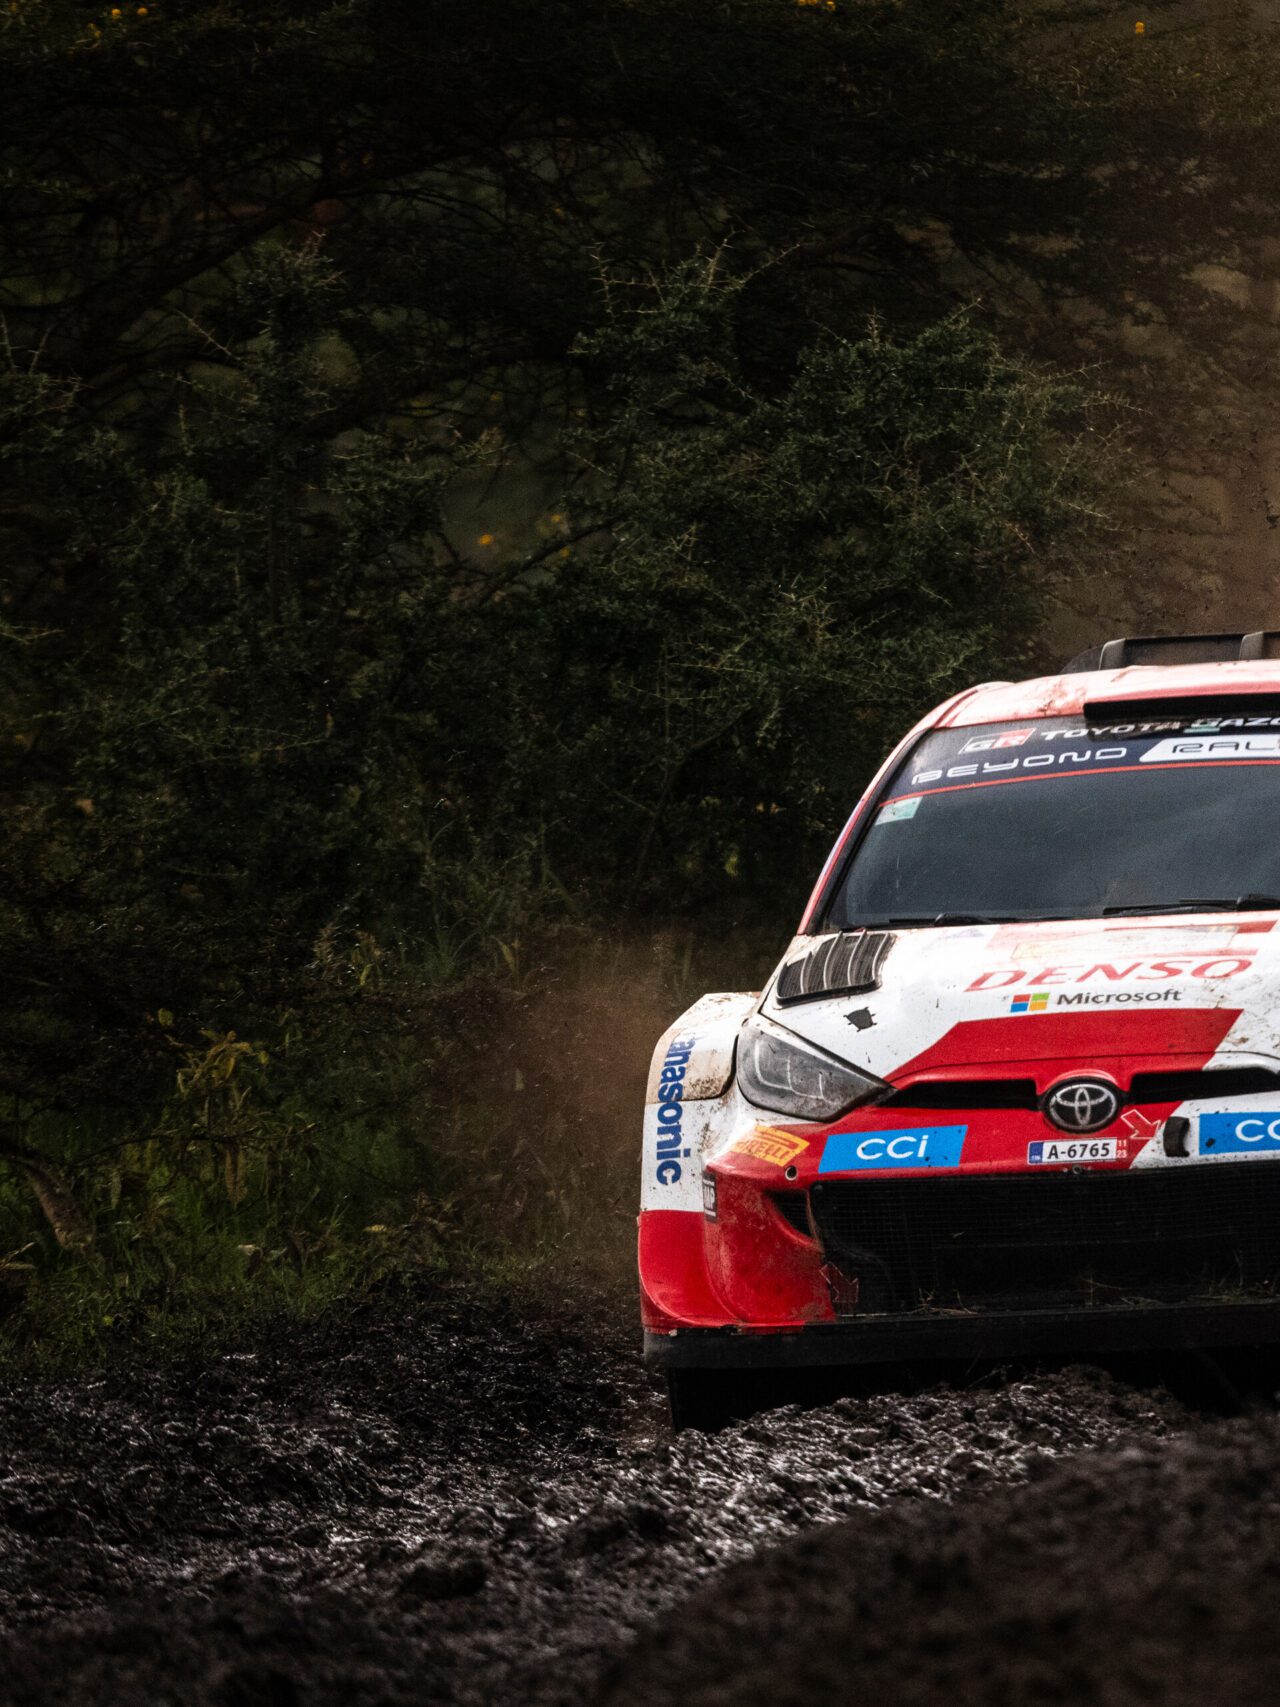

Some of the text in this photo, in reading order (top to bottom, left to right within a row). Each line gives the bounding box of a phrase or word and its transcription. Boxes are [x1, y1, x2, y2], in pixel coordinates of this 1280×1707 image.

[961, 732, 1030, 753] GR
[1040, 721, 1181, 741] TOYOTA
[912, 747, 1127, 785] BEYOND
[964, 959, 1252, 992] DENSO
[1056, 988, 1182, 1006] Microsoft
[656, 1039, 697, 1185] anasonic
[1047, 1143, 1110, 1159] A-6765
